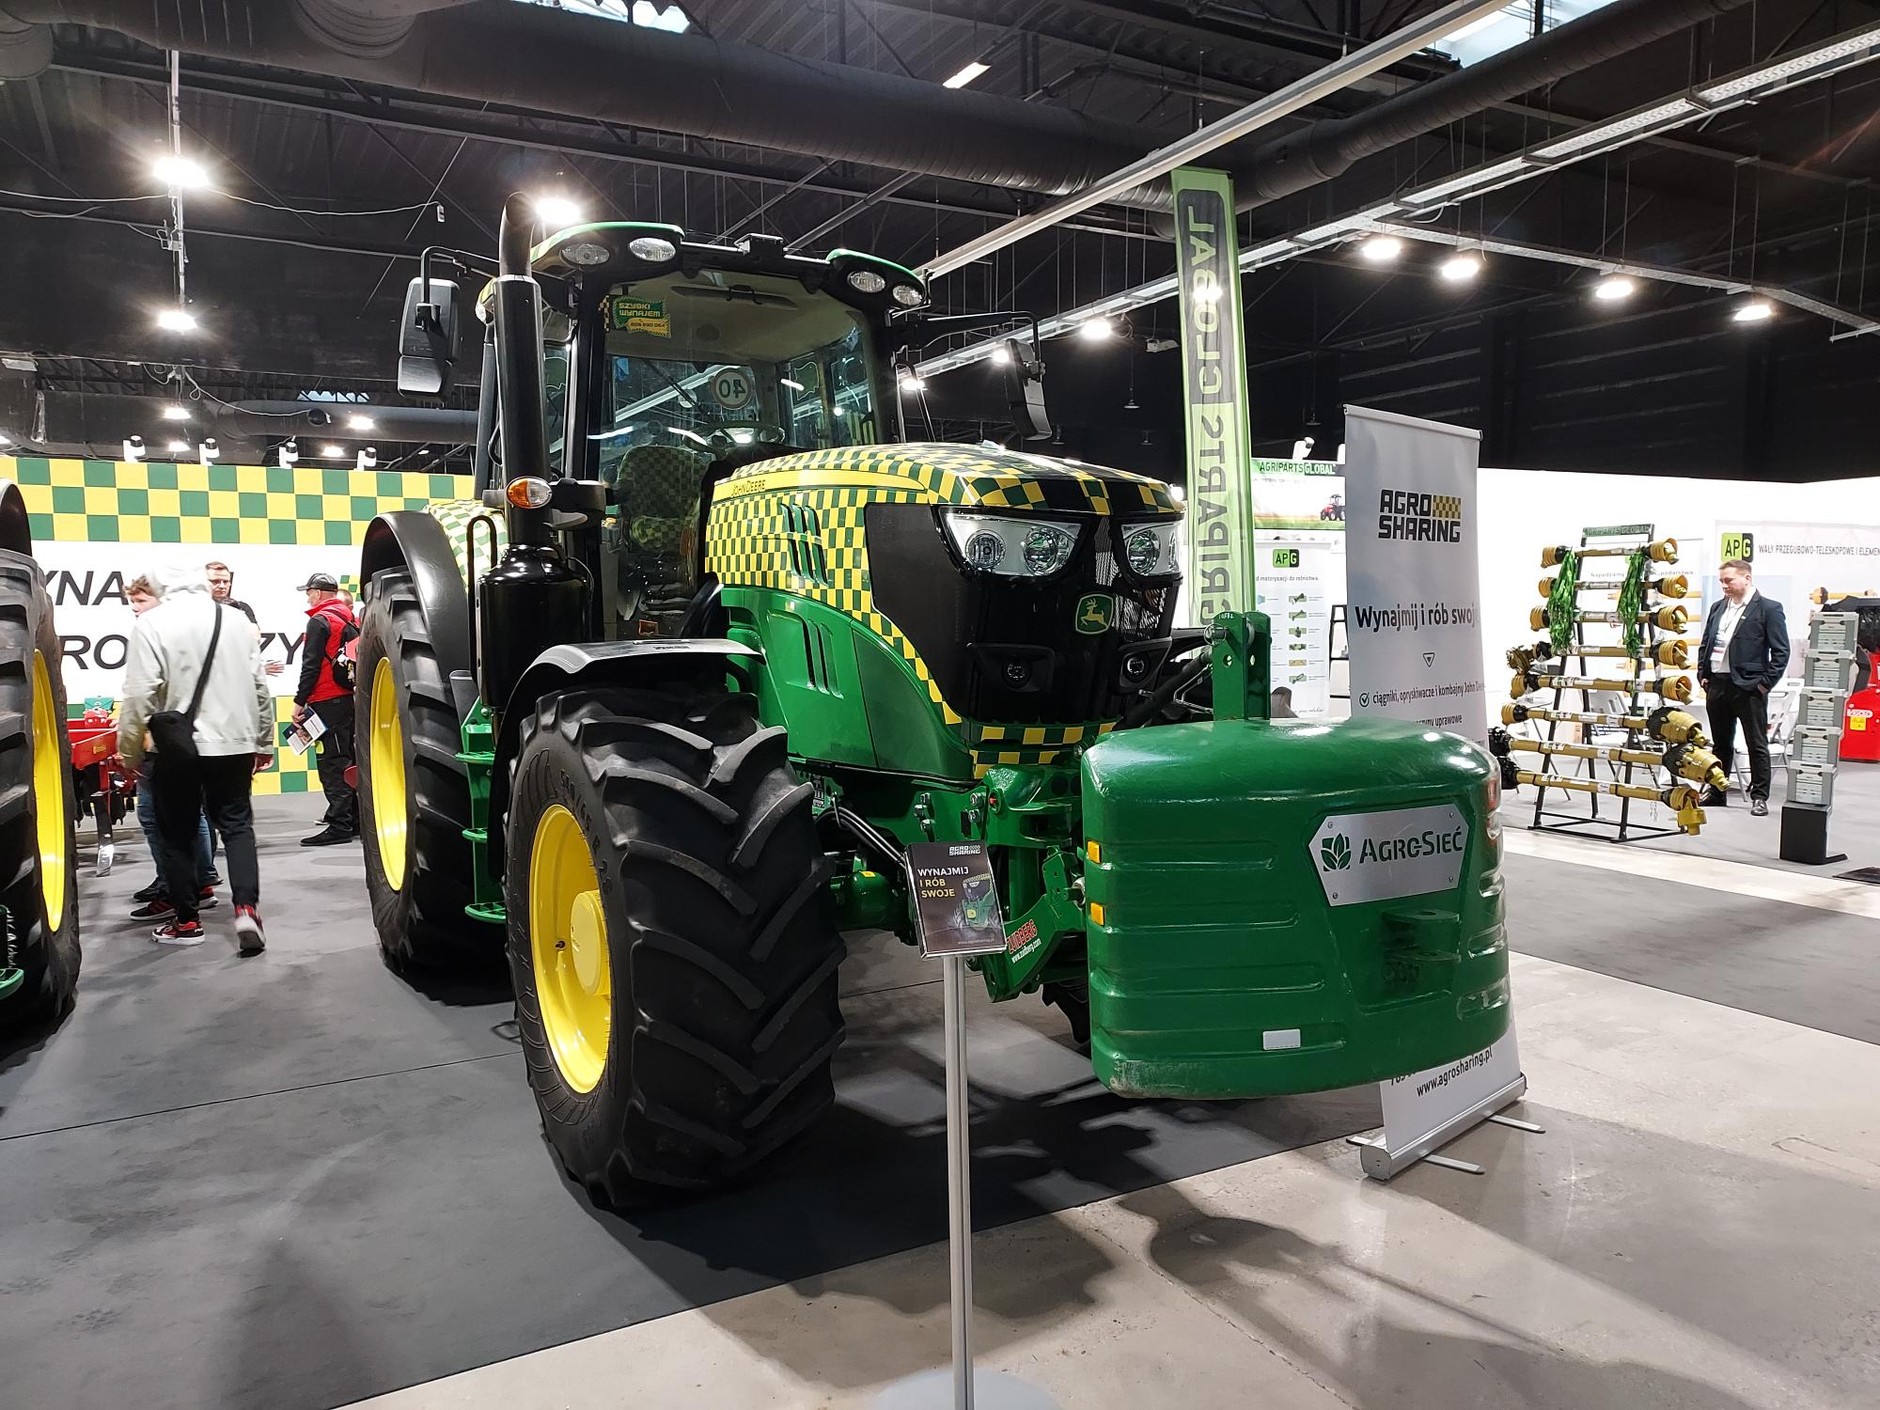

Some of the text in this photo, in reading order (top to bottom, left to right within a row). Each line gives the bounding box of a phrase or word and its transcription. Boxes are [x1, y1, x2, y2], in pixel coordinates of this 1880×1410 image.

[1259, 462, 1336, 475] AGRIPARTS GLOBAL
[1379, 489, 1432, 517] AGRO
[1378, 515, 1461, 543] SHARING
[1725, 538, 1751, 558] APG
[1275, 553, 1297, 564] APG
[1355, 602, 1476, 633] Wynajmij i rób swoj
[1434, 714, 1463, 729] uprawowe
[917, 866, 969, 877] WYNAJMIJ
[919, 877, 946, 888] I RÓB
[921, 888, 956, 898] SWOJE
[1415, 1045, 1493, 1097] www.agrosharing.pl
